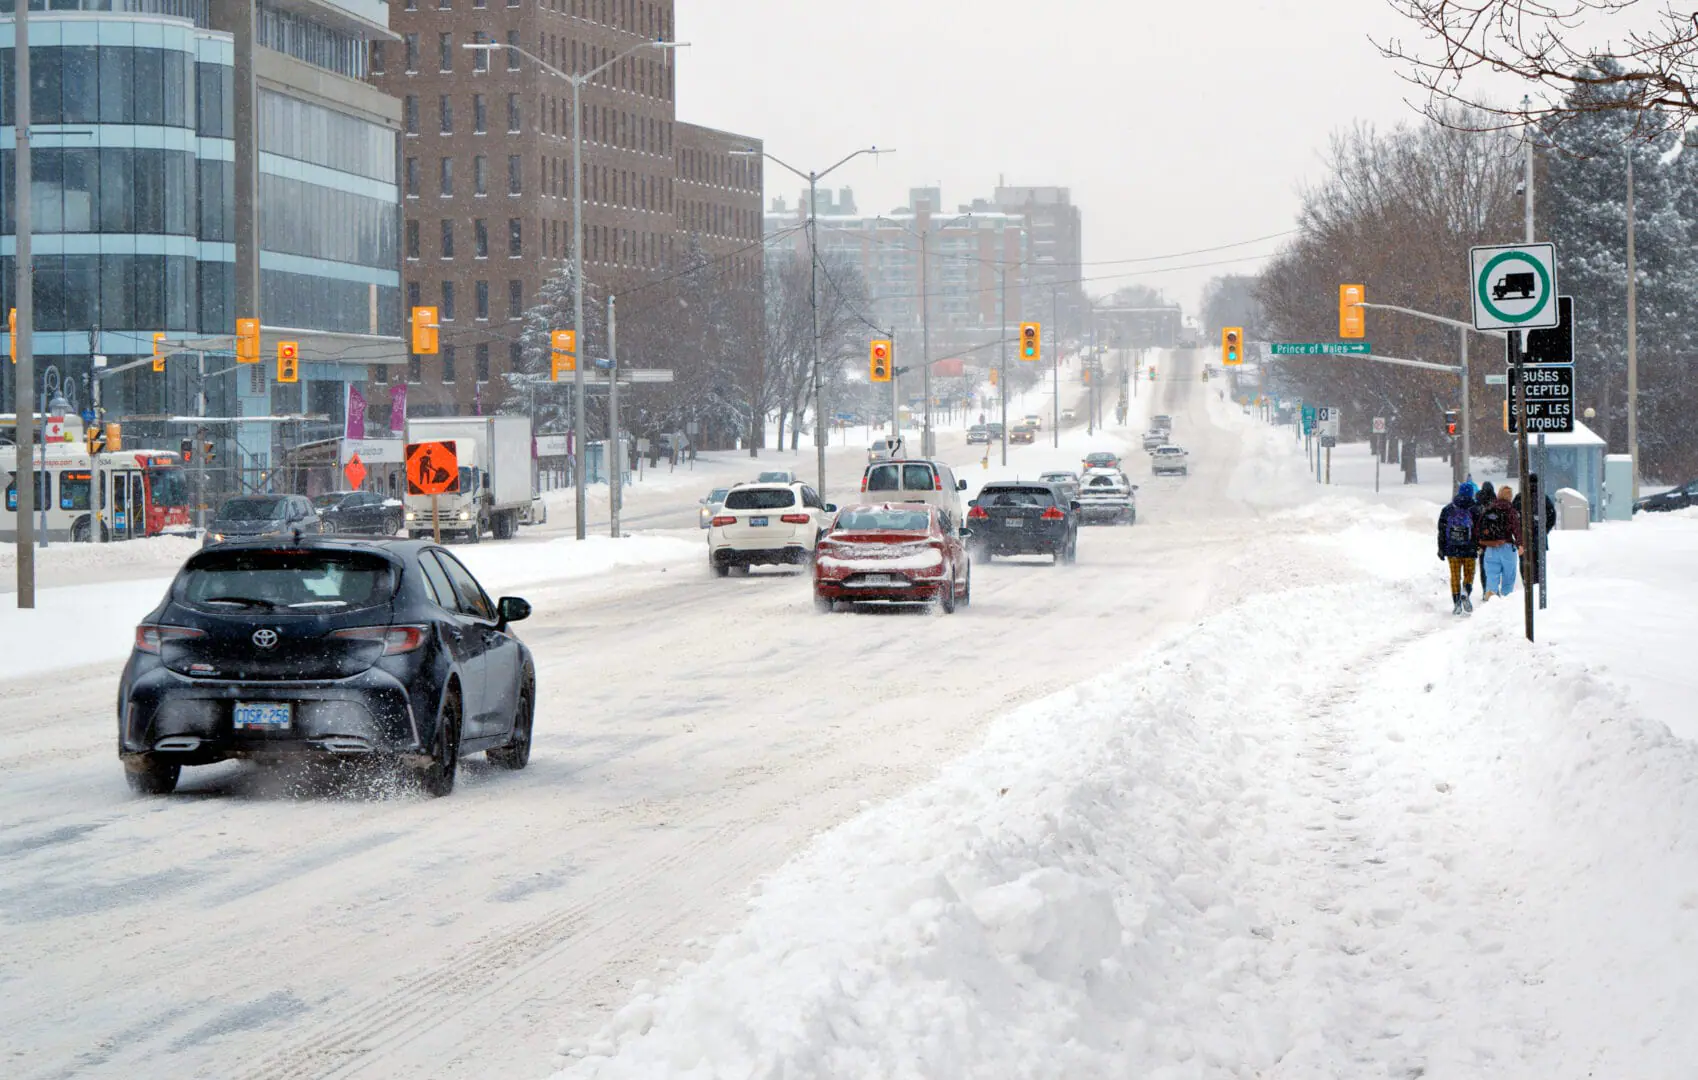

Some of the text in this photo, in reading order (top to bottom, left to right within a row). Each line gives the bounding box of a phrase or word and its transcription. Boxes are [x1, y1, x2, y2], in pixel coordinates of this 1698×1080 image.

[1277, 344, 1348, 354] Prince of Wales
[1523, 370, 1559, 382] BUSES
[1512, 385, 1569, 396] ECEPTED
[1512, 404, 1570, 415] SUF LES
[1514, 418, 1568, 428] TOBUS
